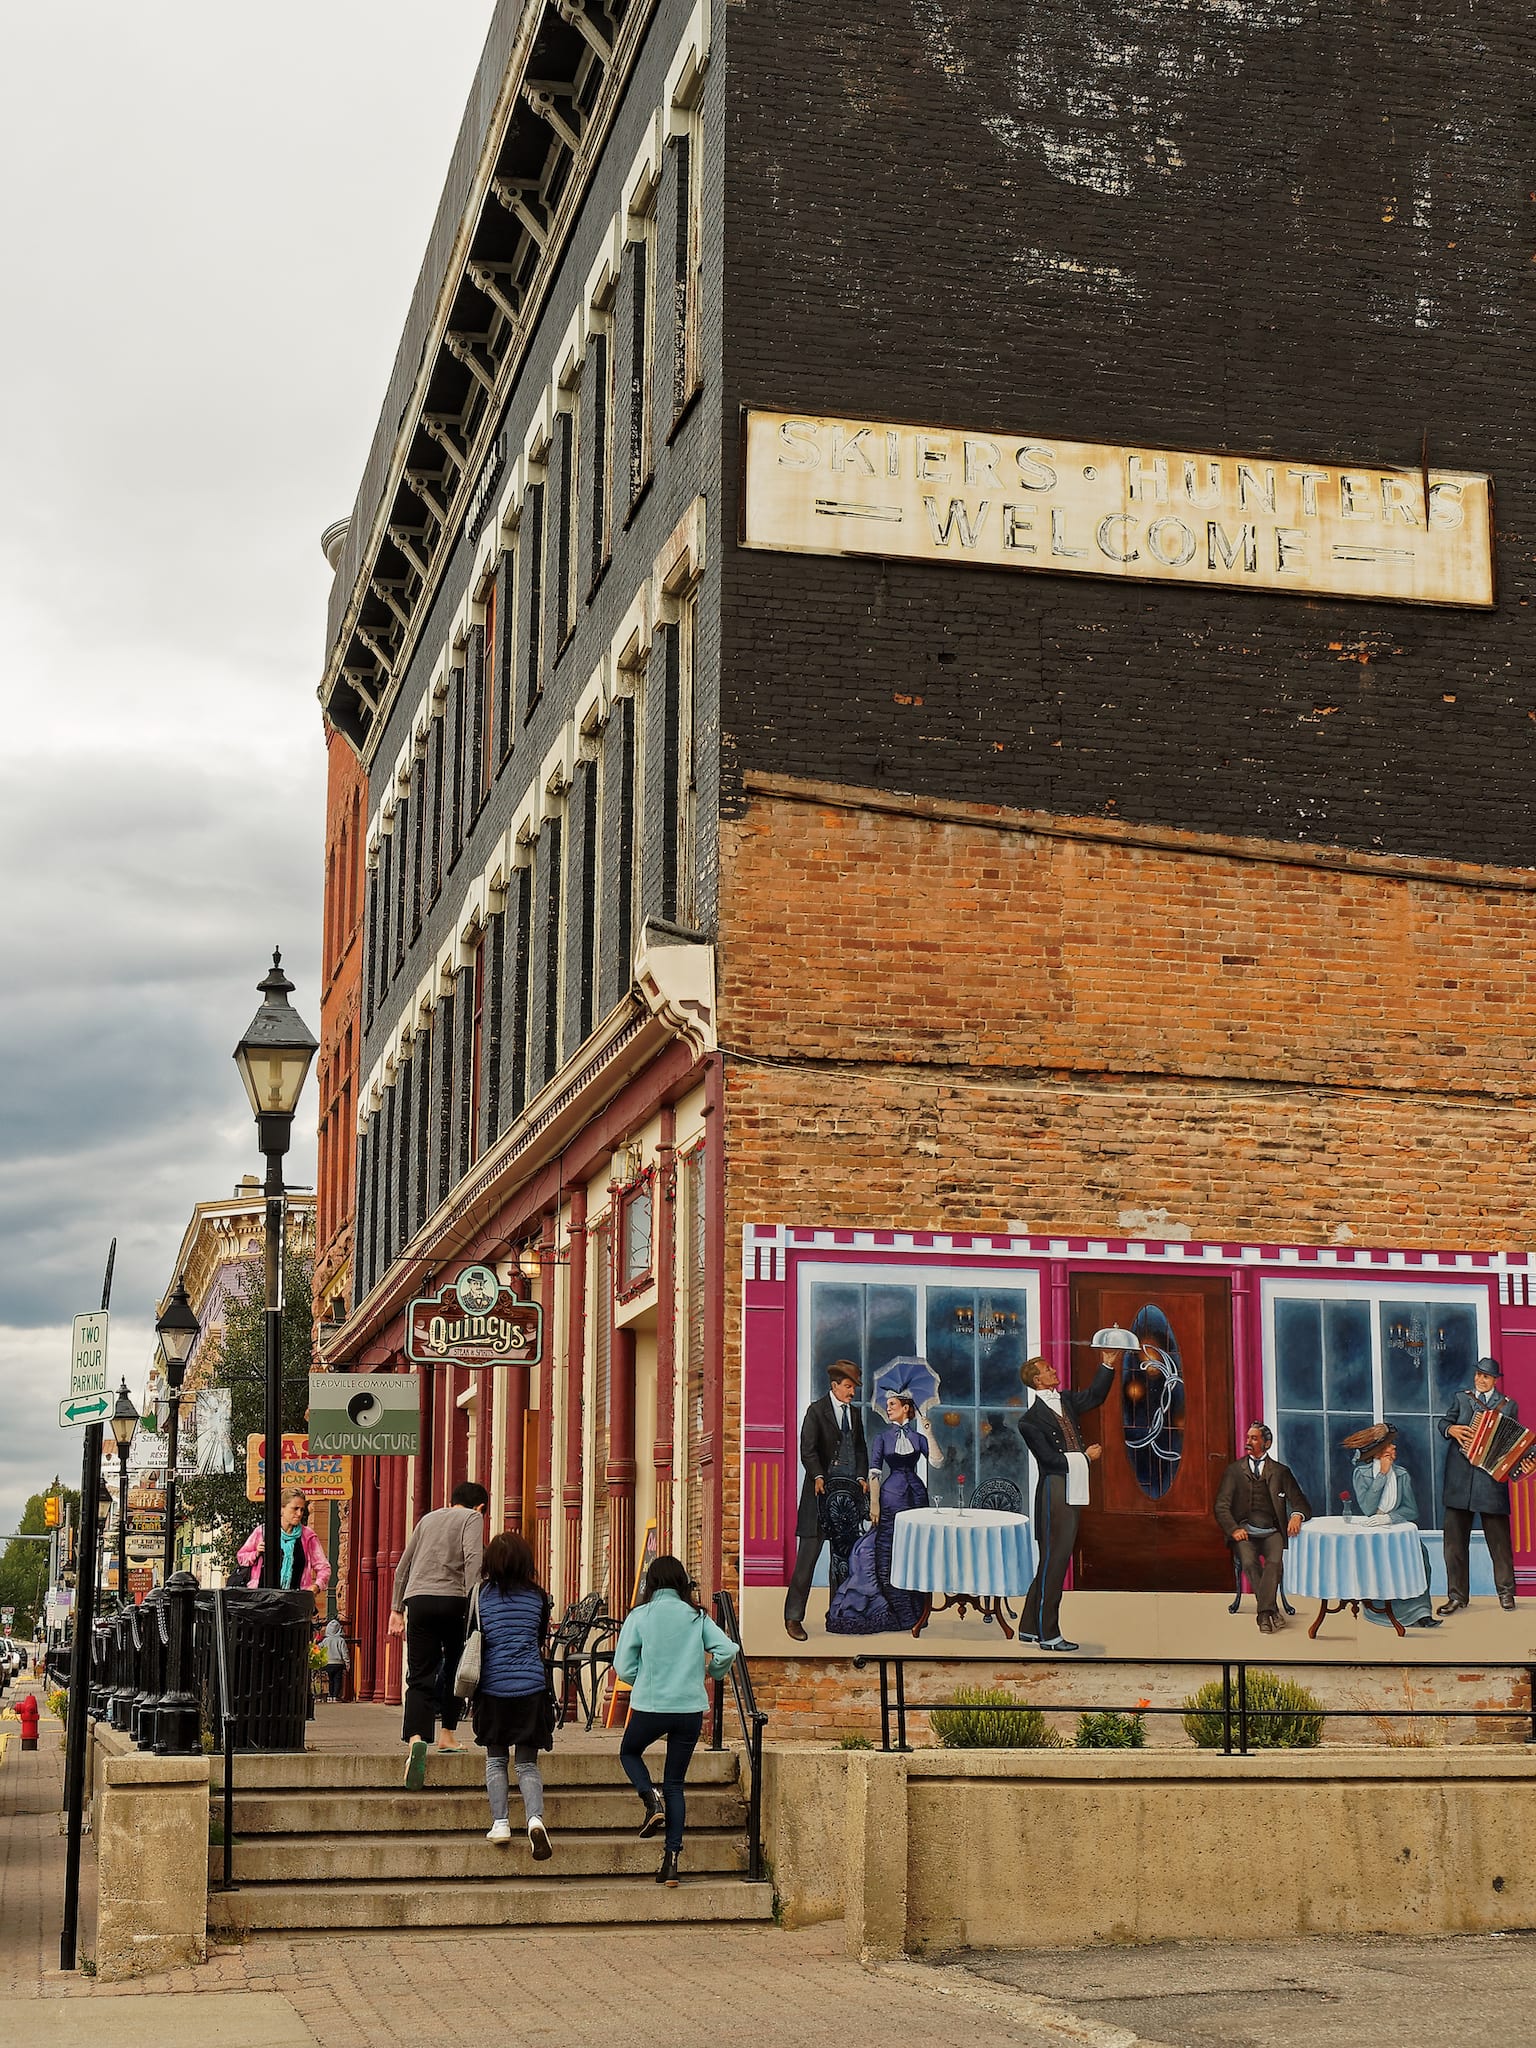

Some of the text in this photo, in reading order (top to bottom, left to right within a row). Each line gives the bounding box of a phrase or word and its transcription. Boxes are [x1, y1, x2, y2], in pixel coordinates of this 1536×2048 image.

[777, 420, 1465, 531] SKIERS HUNTERS
[922, 495, 1312, 576] WELCOME
[81, 1326, 100, 1344] TWO
[429, 1314, 525, 1354] Quincys
[76, 1350, 102, 1368] HOUR
[73, 1373, 104, 1393] PARKING
[312, 1380, 417, 1389] LEADVILLE COMMUNITY
[312, 1433, 417, 1450] ACUPUNCTURE
[314, 1475, 343, 1484] FOOD
[323, 1487, 344, 1495] Dinner
[136, 1499, 160, 1507] HIVE
